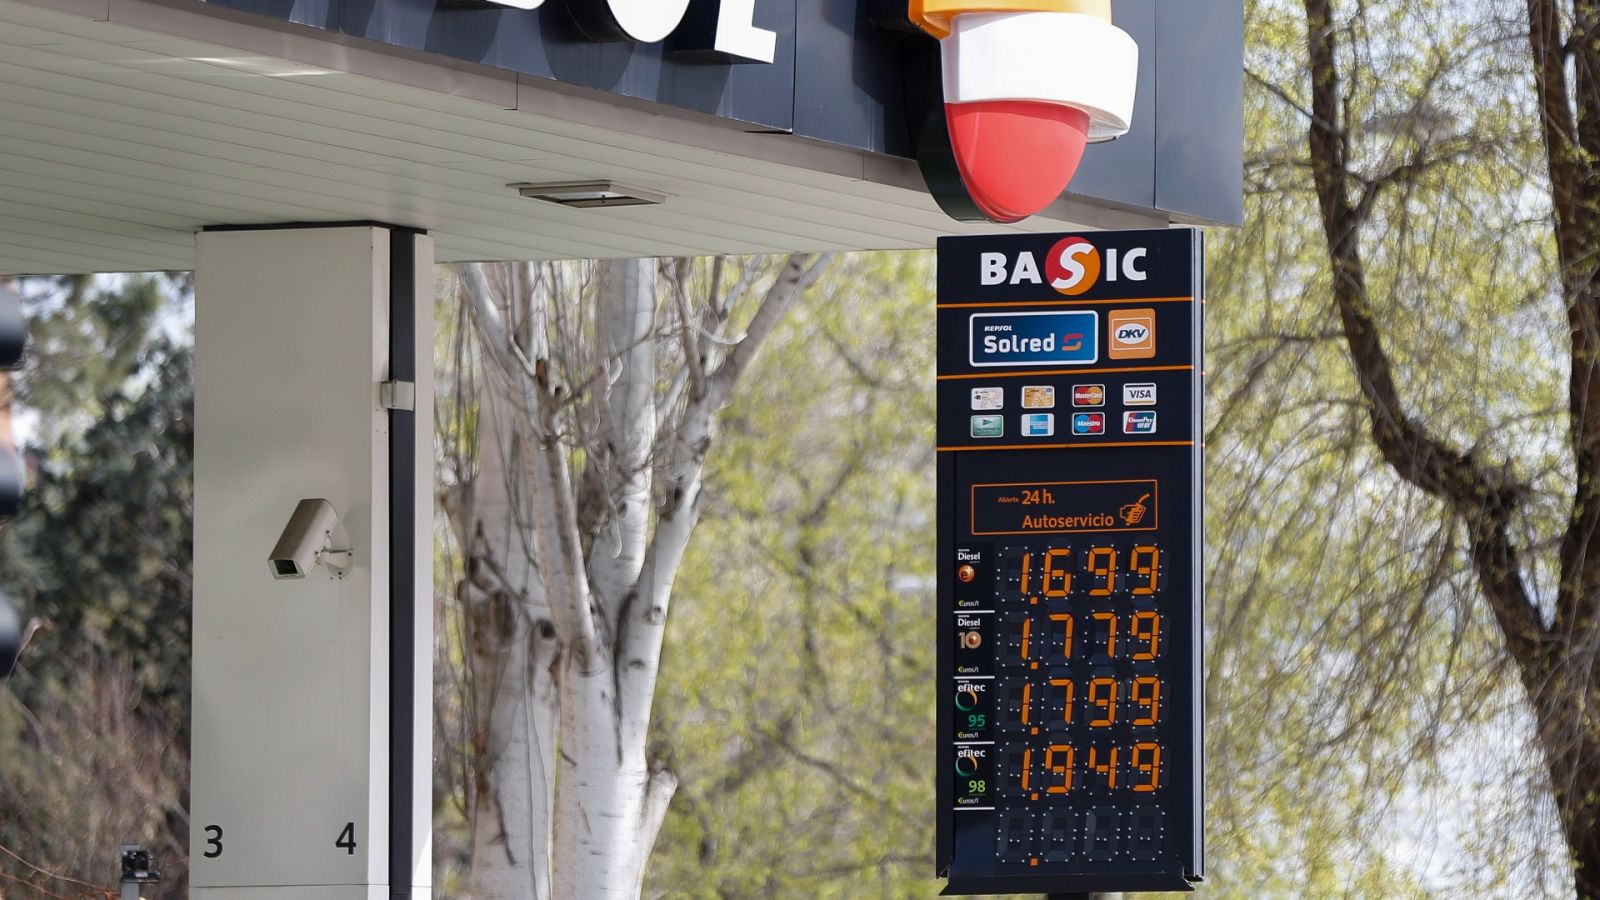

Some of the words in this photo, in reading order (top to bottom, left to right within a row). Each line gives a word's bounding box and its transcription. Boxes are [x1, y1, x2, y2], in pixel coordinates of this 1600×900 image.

[981, 242, 1147, 289] BASIC
[1118, 328, 1147, 339] DKV
[984, 333, 1055, 354] Solred
[1129, 390, 1152, 399] VISA
[1022, 490, 1041, 505] 24
[1043, 489, 1056, 504] h.
[1022, 513, 1114, 529] Autoservicio
[958, 552, 981, 561] Diesel
[1021, 546, 1160, 605] 1.699
[958, 618, 981, 627] Diesel
[1021, 611, 1160, 670] 1.779
[957, 683, 986, 692] efitec
[1021, 676, 1161, 735] 1.799
[968, 714, 986, 728] 95
[957, 749, 986, 758] efitec
[1021, 742, 1161, 801] 1.949
[968, 780, 986, 793] 98
[203, 824, 224, 859] 3
[335, 822, 357, 855] 4
